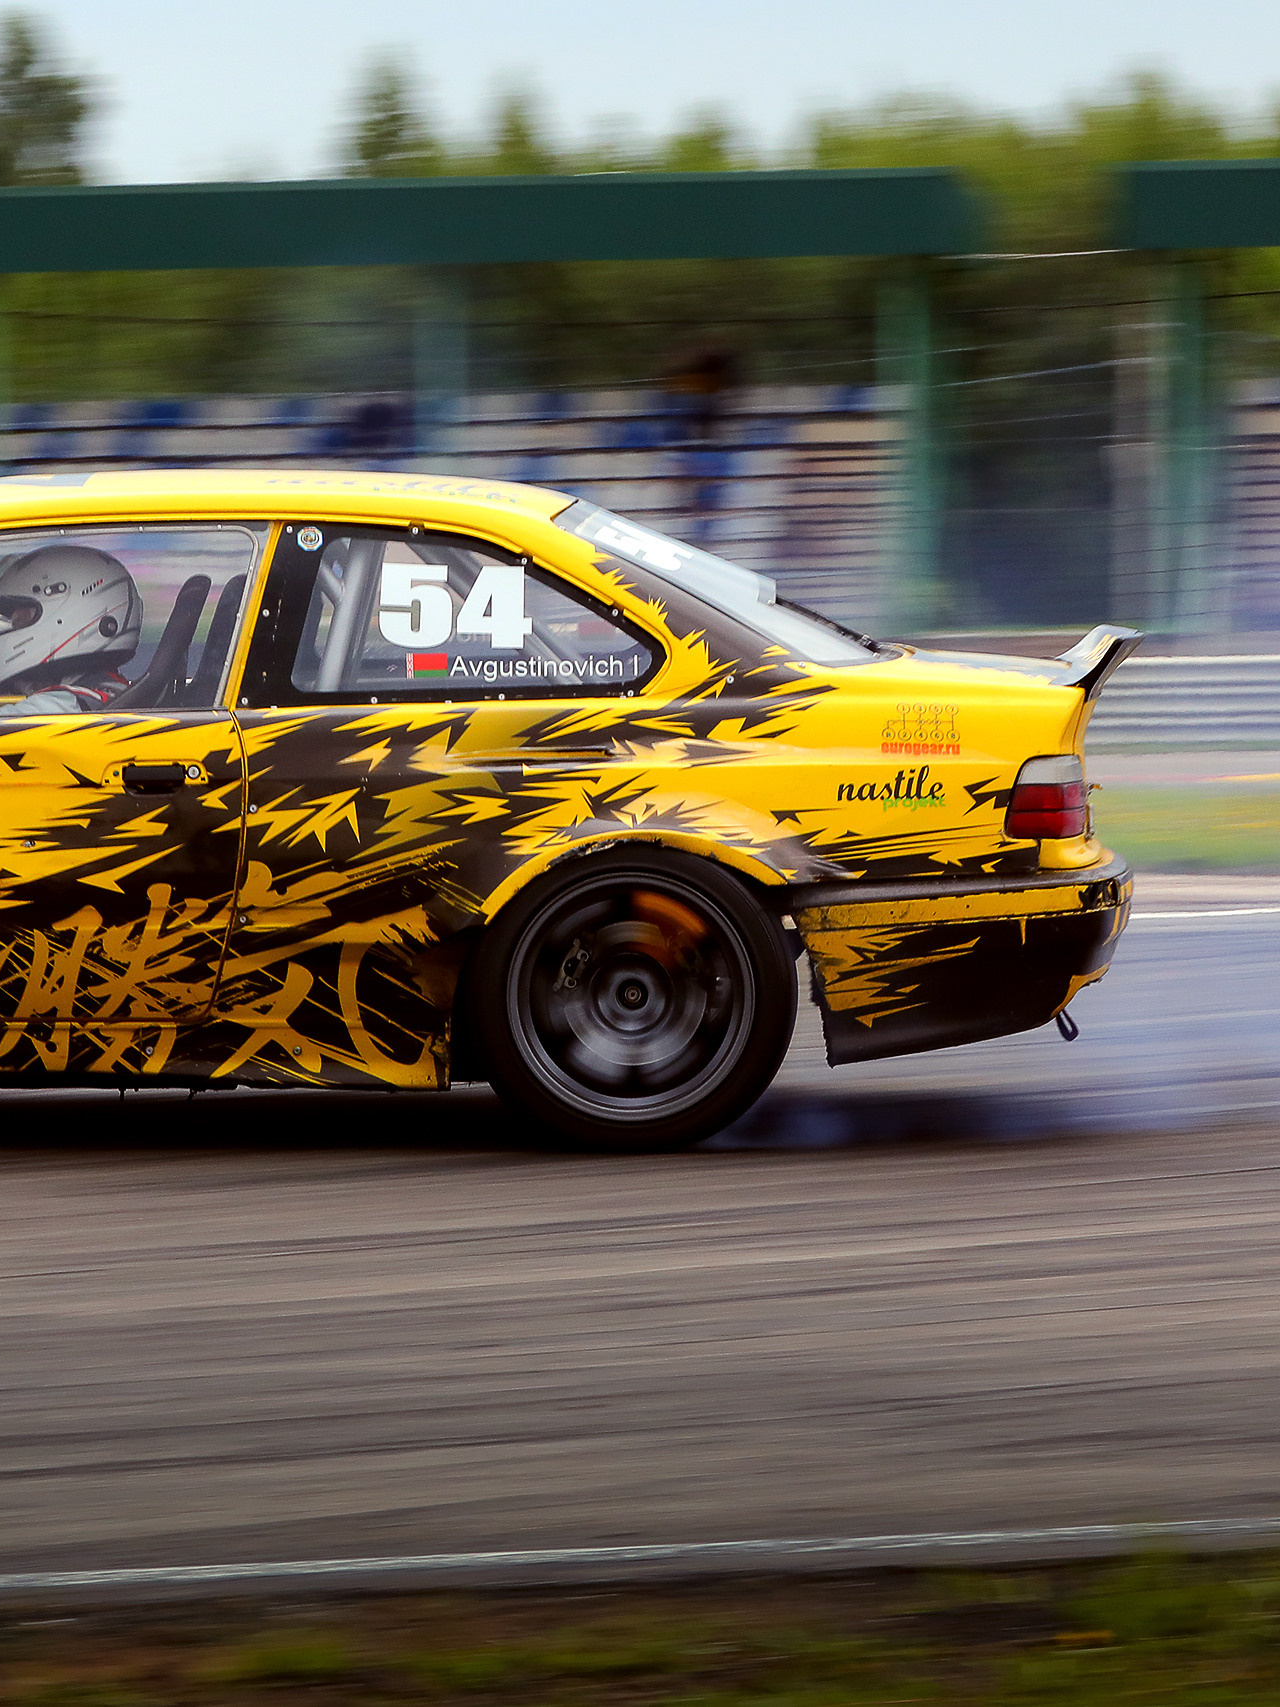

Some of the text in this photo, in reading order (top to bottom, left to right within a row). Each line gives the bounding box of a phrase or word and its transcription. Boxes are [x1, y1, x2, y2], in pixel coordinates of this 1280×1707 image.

[379, 562, 532, 649] 54
[450, 656, 623, 681] Avgustinovich
[880, 742, 960, 755] eurogear.ru
[838, 765, 945, 801] nastile
[883, 795, 946, 811] projekt
